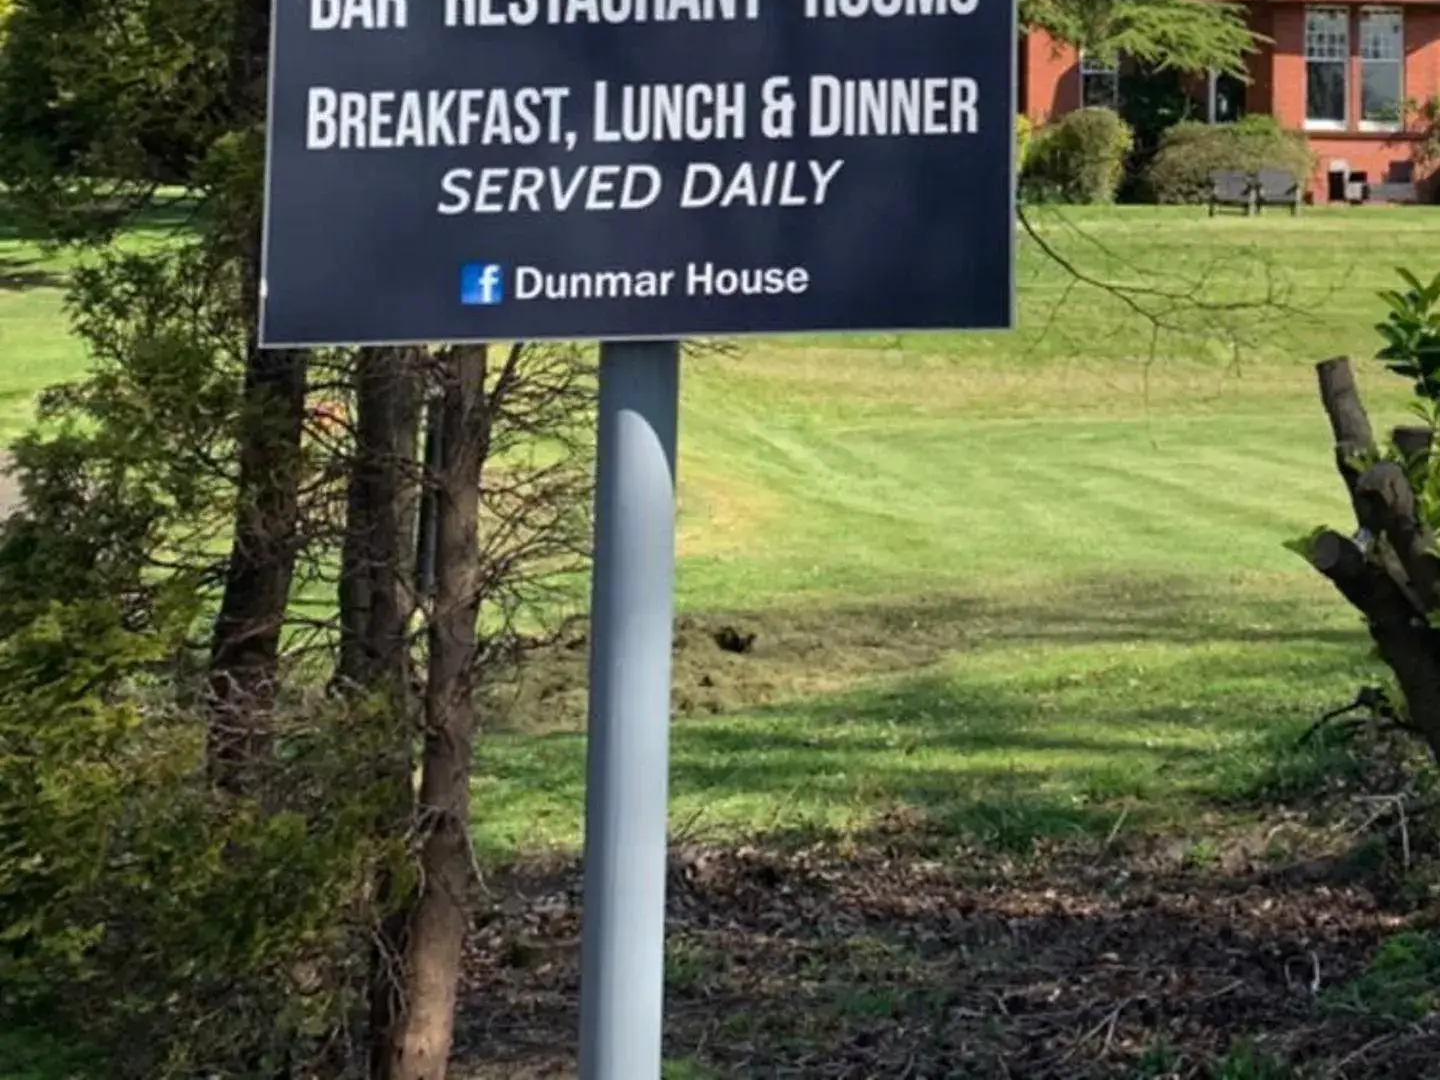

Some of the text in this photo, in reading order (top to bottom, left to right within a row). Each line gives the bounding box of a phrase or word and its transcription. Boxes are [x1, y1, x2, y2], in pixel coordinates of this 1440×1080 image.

[306, 75, 978, 151] BREAKFAST, LUNCH & DINNER
[437, 159, 844, 215] SERVED DAILY
[515, 266, 675, 300] Dunmar
[687, 262, 809, 296] House
